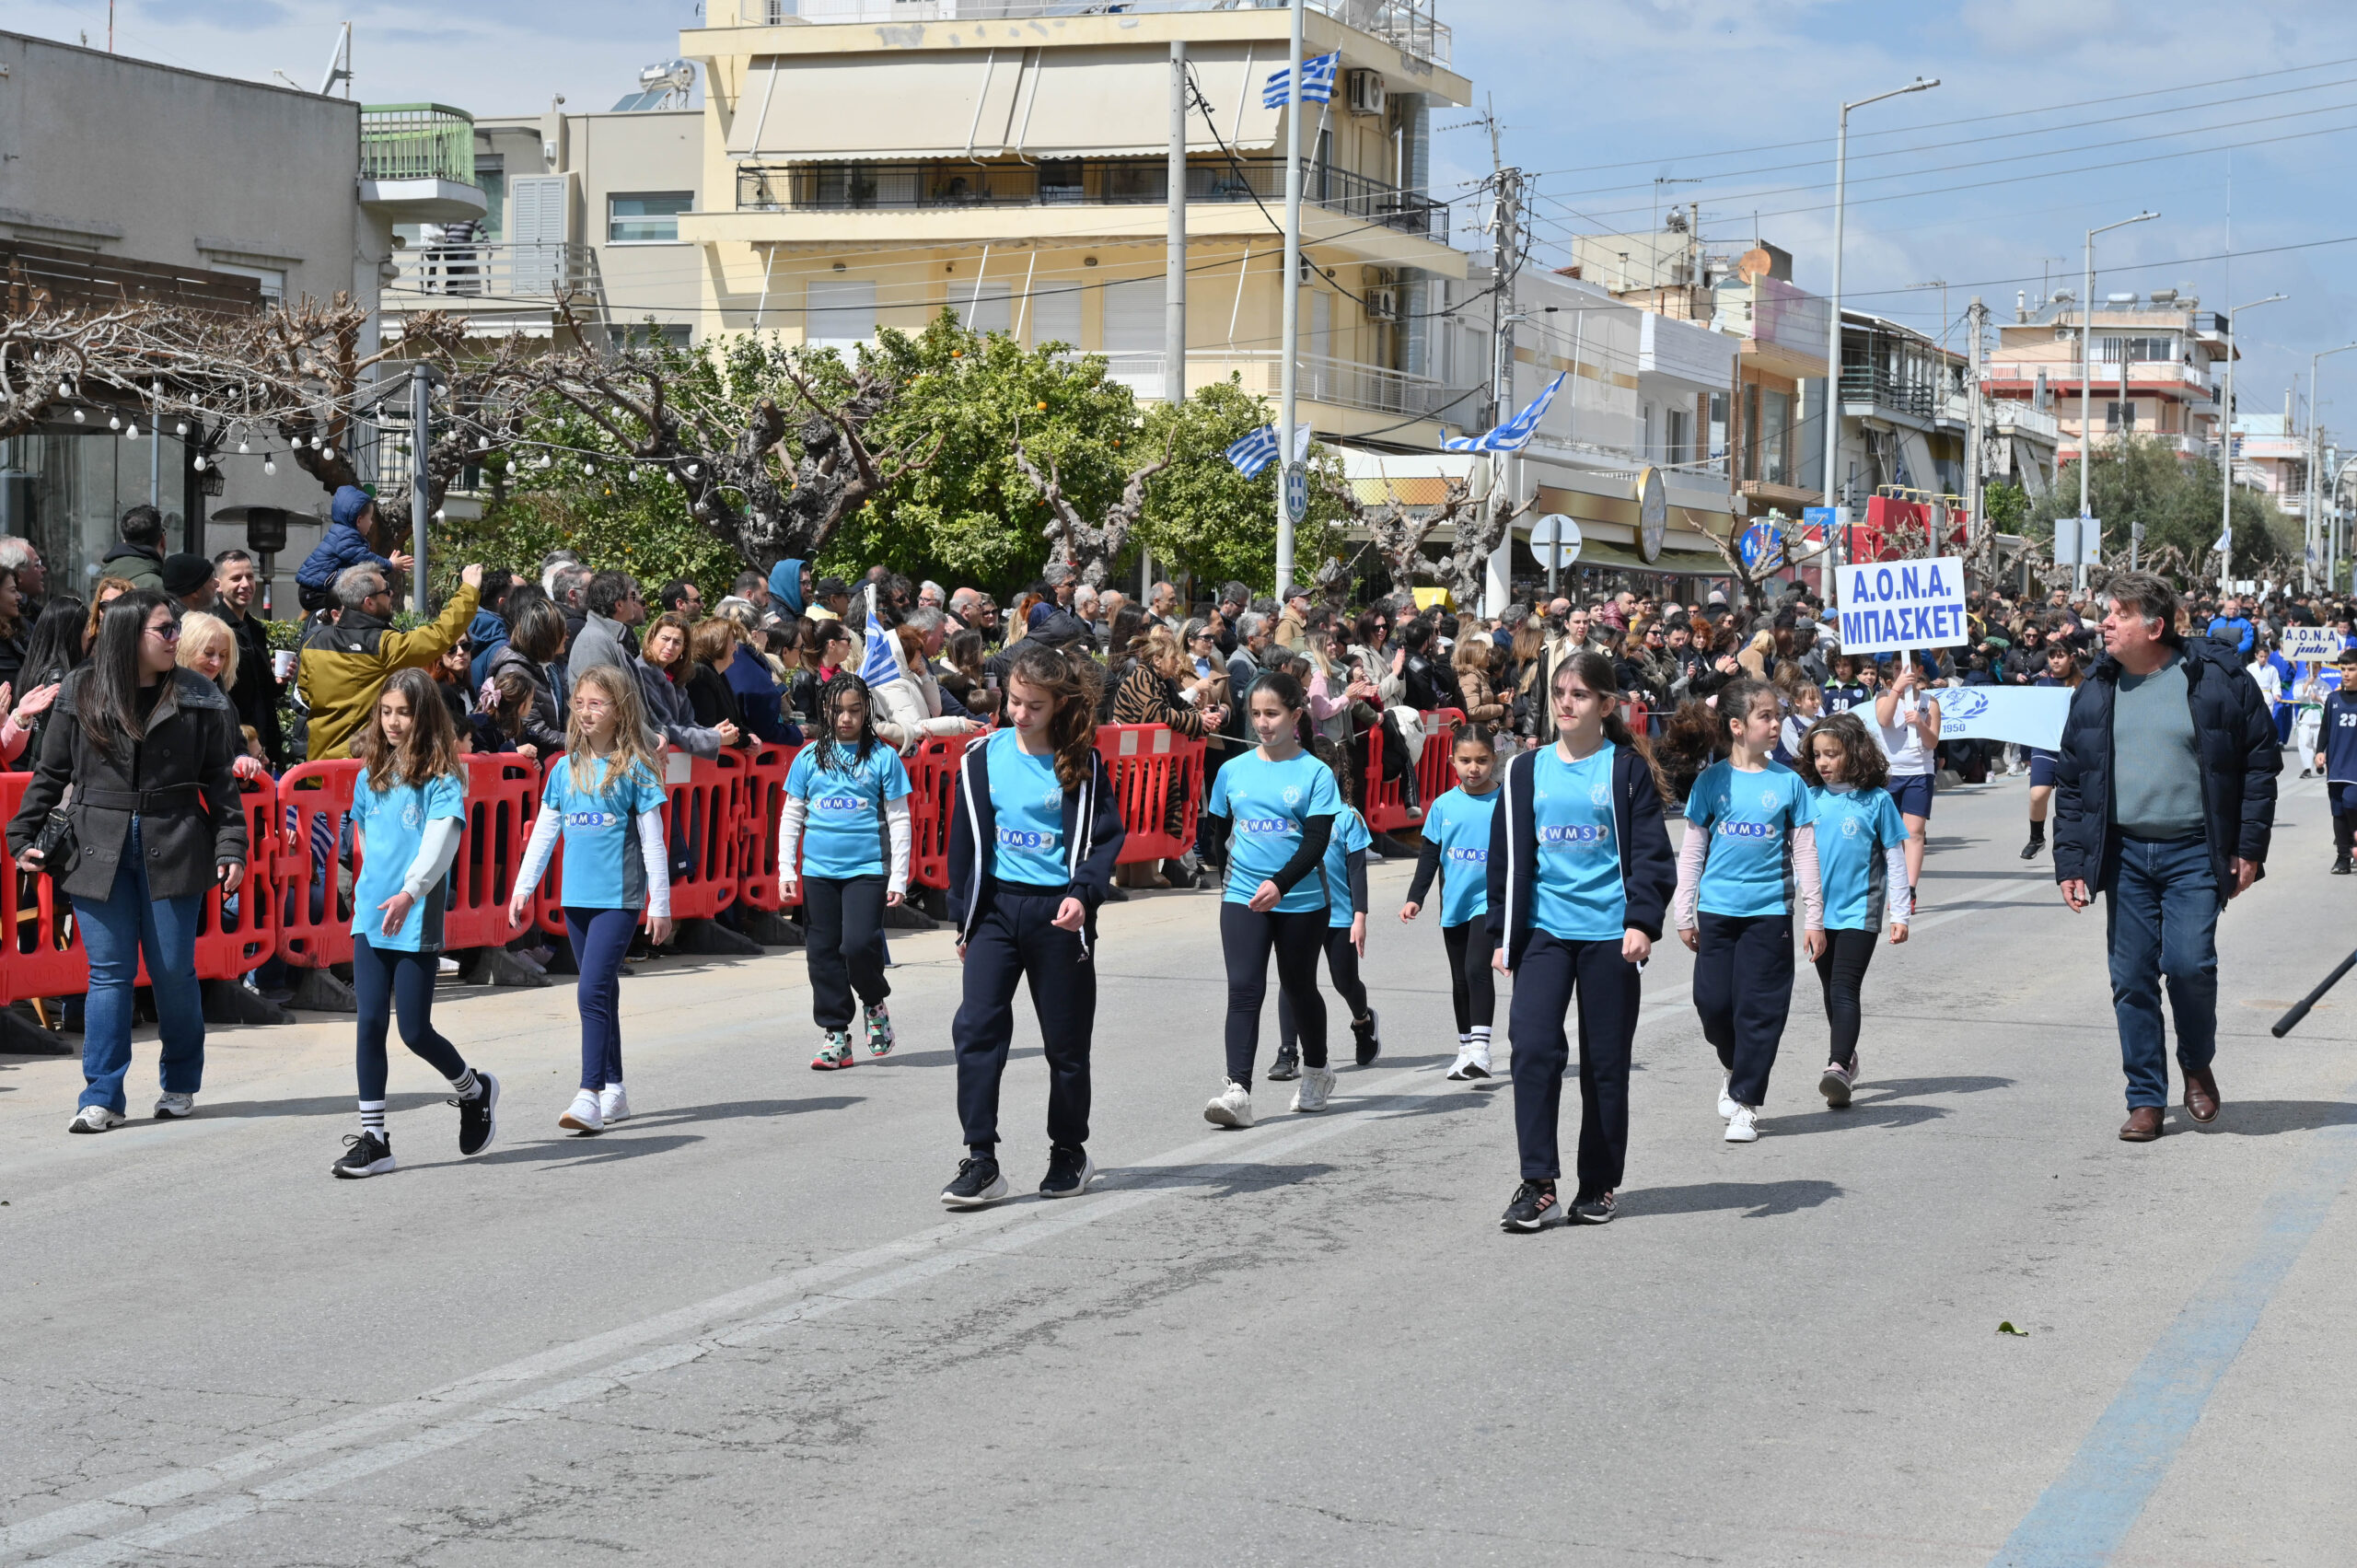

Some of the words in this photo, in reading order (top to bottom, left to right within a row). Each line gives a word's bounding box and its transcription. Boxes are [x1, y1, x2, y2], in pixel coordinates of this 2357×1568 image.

[1852, 564, 1952, 604] Α.Ο.Ν.Α.
[1842, 604, 1963, 645] ΜΠΑΣΚΕΤ
[2293, 642, 2328, 657] judo
[1832, 698, 1849, 711] 30
[2339, 713, 2357, 727] 23
[1943, 723, 1966, 734] 1950
[822, 799, 853, 808] WMS
[1249, 820, 1283, 830] WMS
[1728, 823, 1761, 835] WMS
[1002, 830, 1035, 845] WMS
[1549, 828, 1591, 839] WMS
[1456, 849, 1486, 860] WMS
